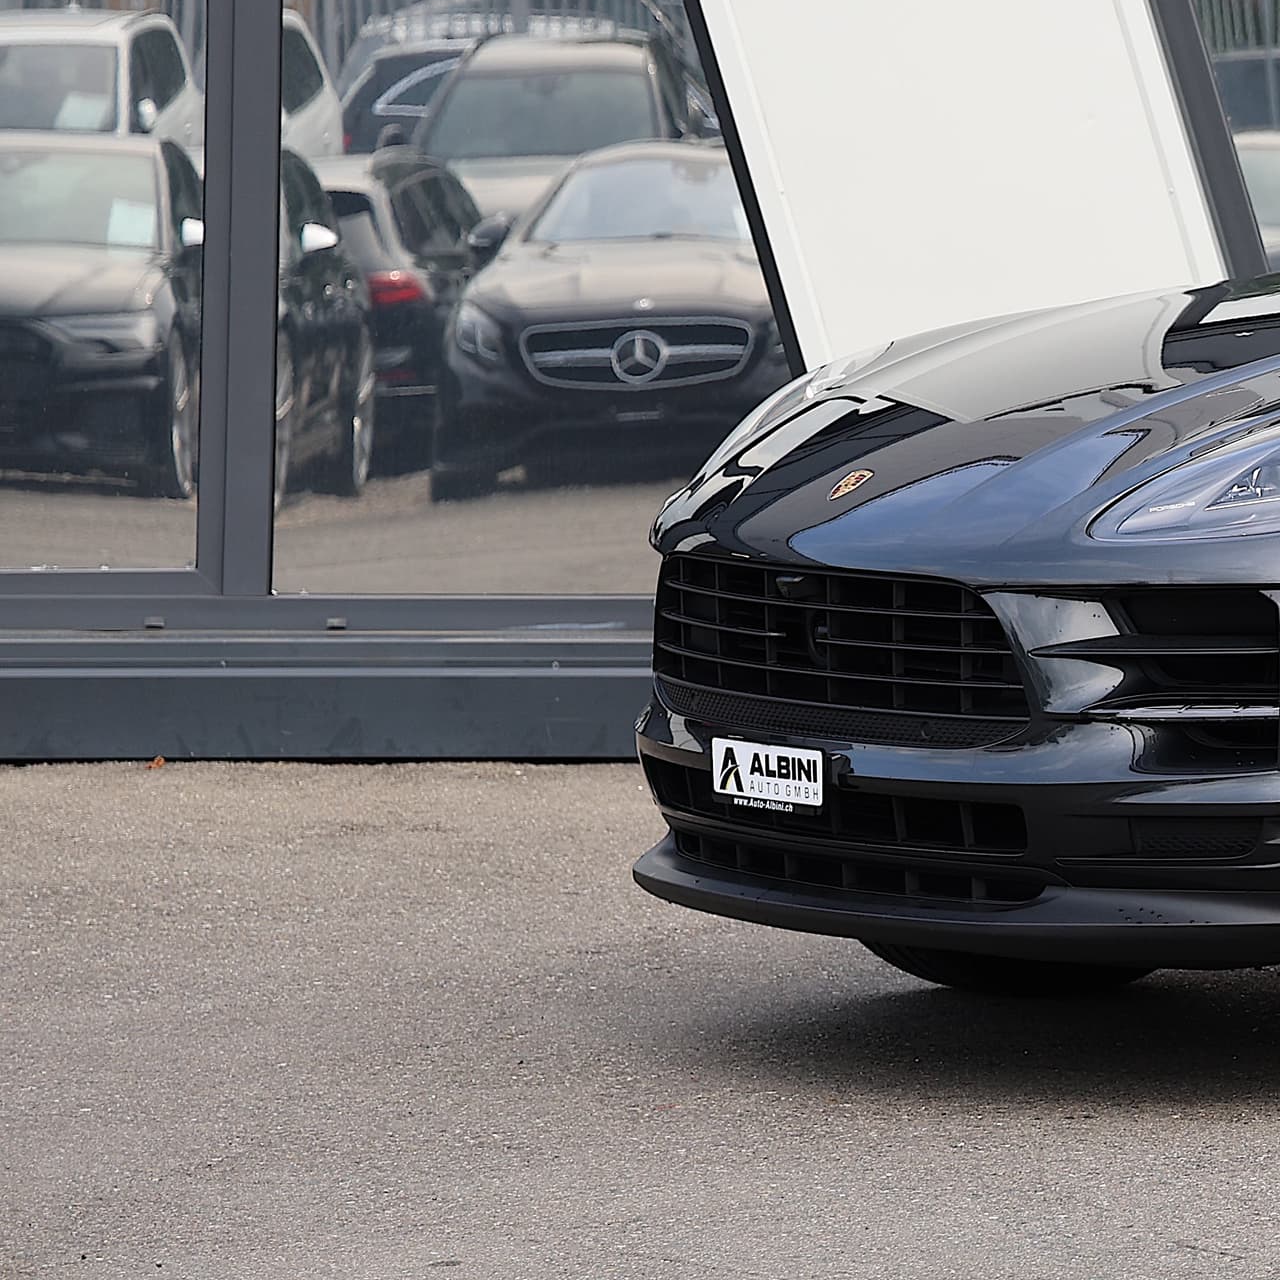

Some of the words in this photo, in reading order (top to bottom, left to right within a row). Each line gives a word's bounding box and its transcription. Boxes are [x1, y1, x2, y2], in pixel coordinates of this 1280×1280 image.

[749, 752, 818, 783] ALBINI
[749, 779, 780, 796] AUTO
[786, 785, 818, 800] GMBH
[734, 797, 793, 812] www.Auto-Albini.ch
